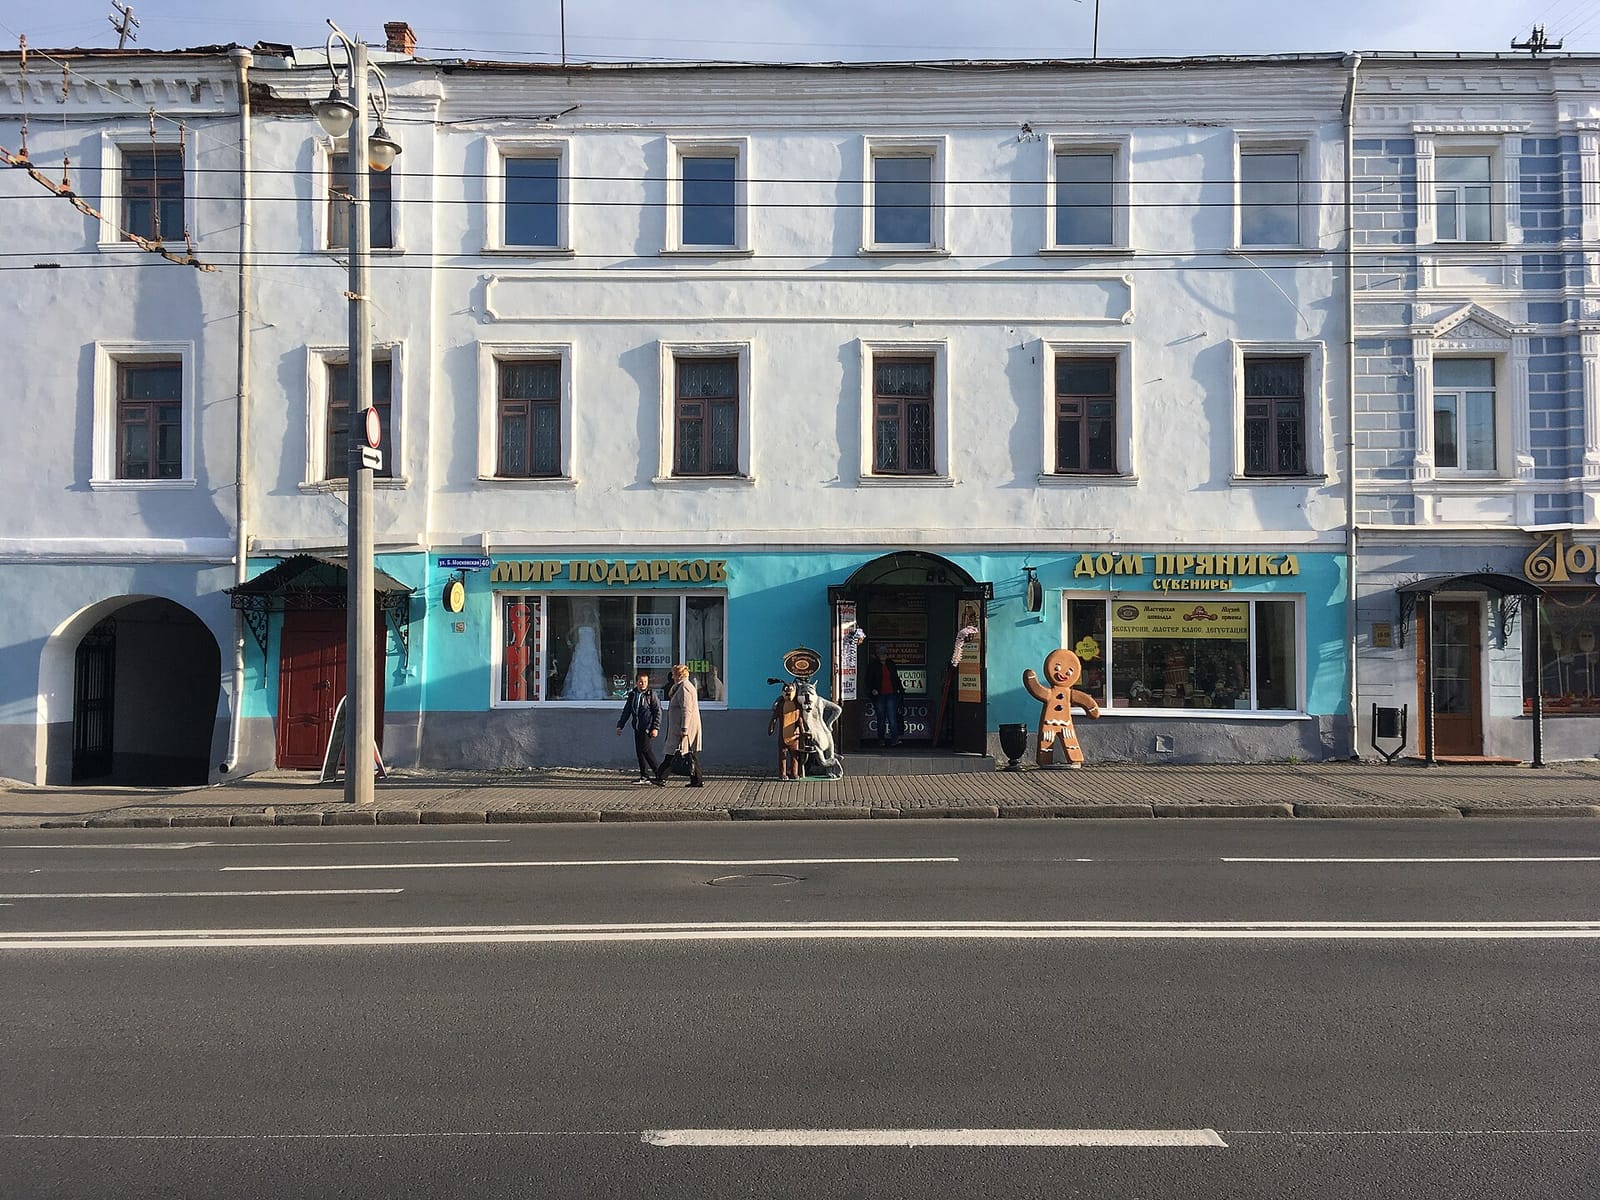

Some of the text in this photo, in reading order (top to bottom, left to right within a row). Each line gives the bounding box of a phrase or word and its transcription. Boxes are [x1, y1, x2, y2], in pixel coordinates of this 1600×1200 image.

[481, 559, 490, 567] 40
[1073, 553, 1300, 578] ДОМ ПРЯНИКА
[490, 559, 728, 586] МИР ПОДАРКОВ
[1152, 578, 1233, 596] СУВЕНИРЫ
[636, 617, 671, 626] ЗОЛОТО
[639, 627, 668, 635] SILVER
[641, 647, 665, 655] GOLD
[636, 655, 671, 664] СЕРЕБРО
[904, 671, 926, 679] САЛОН
